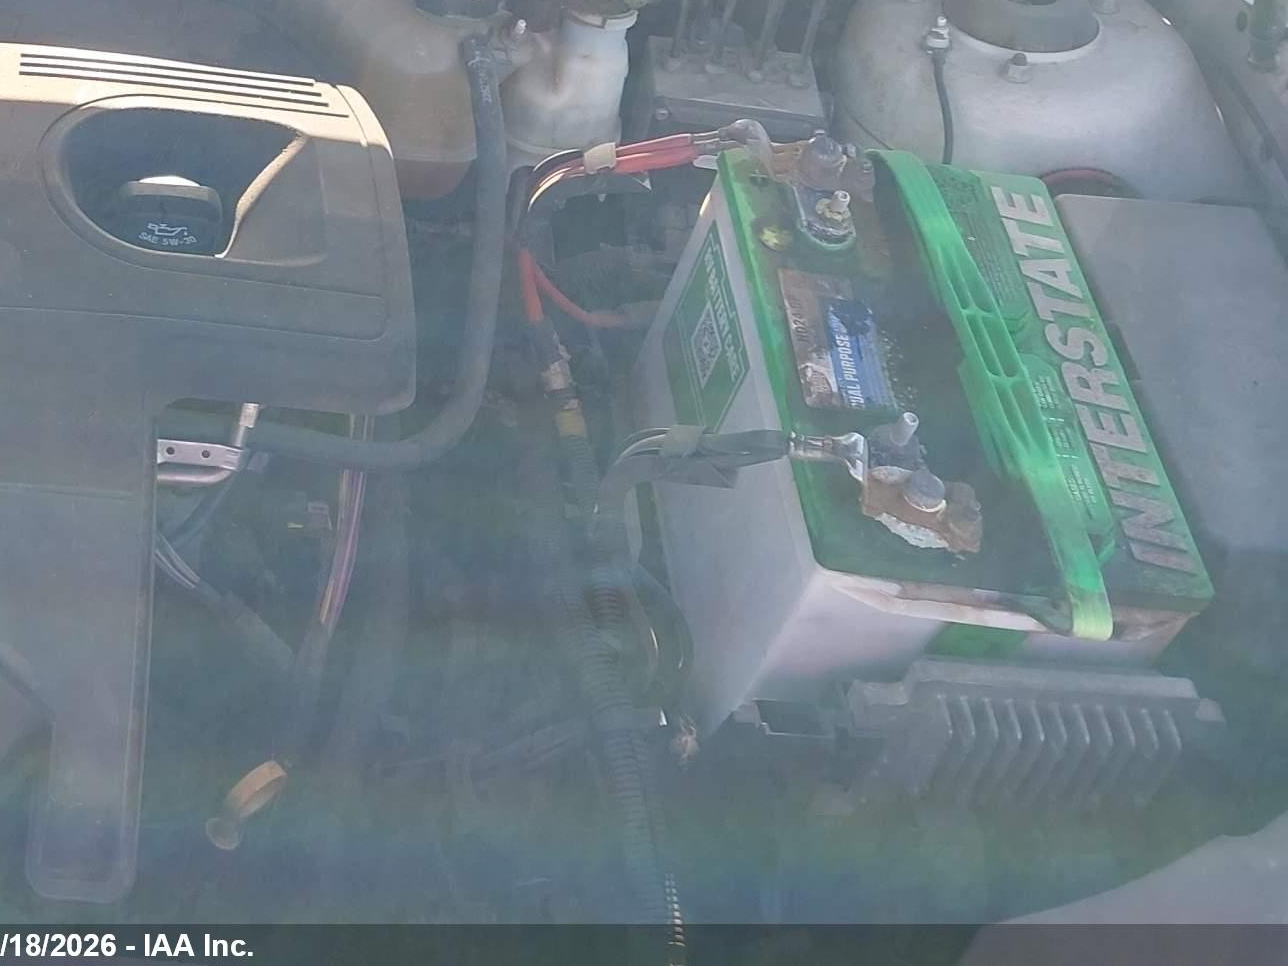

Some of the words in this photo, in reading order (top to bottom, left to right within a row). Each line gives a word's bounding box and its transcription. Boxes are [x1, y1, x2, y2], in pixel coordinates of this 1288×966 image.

[138, 232, 159, 244] SAE
[834, 334, 861, 381] PURPOSE
[990, 185, 1198, 576] INTERSTATE
